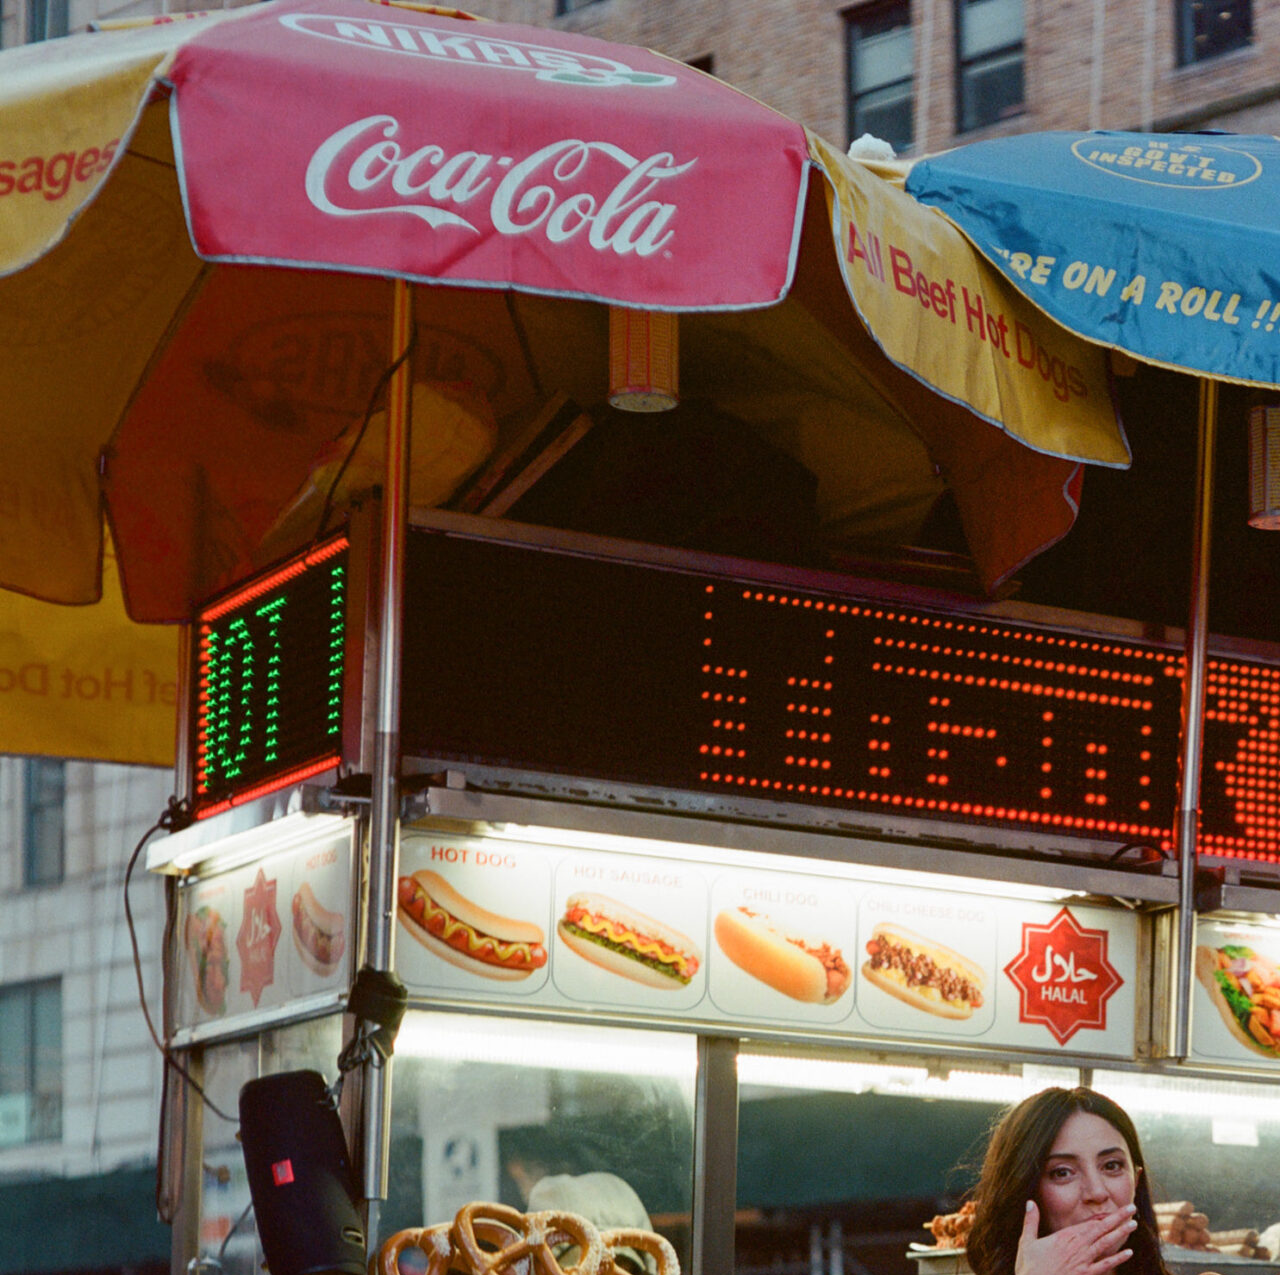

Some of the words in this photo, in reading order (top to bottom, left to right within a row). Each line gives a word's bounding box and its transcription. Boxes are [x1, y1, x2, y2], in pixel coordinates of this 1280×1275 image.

[335, 21, 578, 71] NIKAS
[1088, 150, 1237, 184] INSPECTED
[304, 114, 698, 258] Coca-Cola
[847, 221, 886, 283] All
[888, 244, 957, 325] Beef
[961, 286, 1011, 359] Hot
[1014, 319, 1089, 403] Dogs
[1062, 261, 1117, 297] ON
[1120, 274, 1147, 305] A
[1155, 281, 1241, 326] ROLL
[430, 845, 471, 864] HOT
[475, 849, 517, 869] DOG
[573, 863, 604, 880] HOT
[613, 867, 684, 889] SAUSAGE
[742, 886, 782, 903] CHILI
[786, 891, 819, 907] DOG
[1031, 944, 1099, 984] حلال
[1041, 985, 1088, 1005] HALAL
